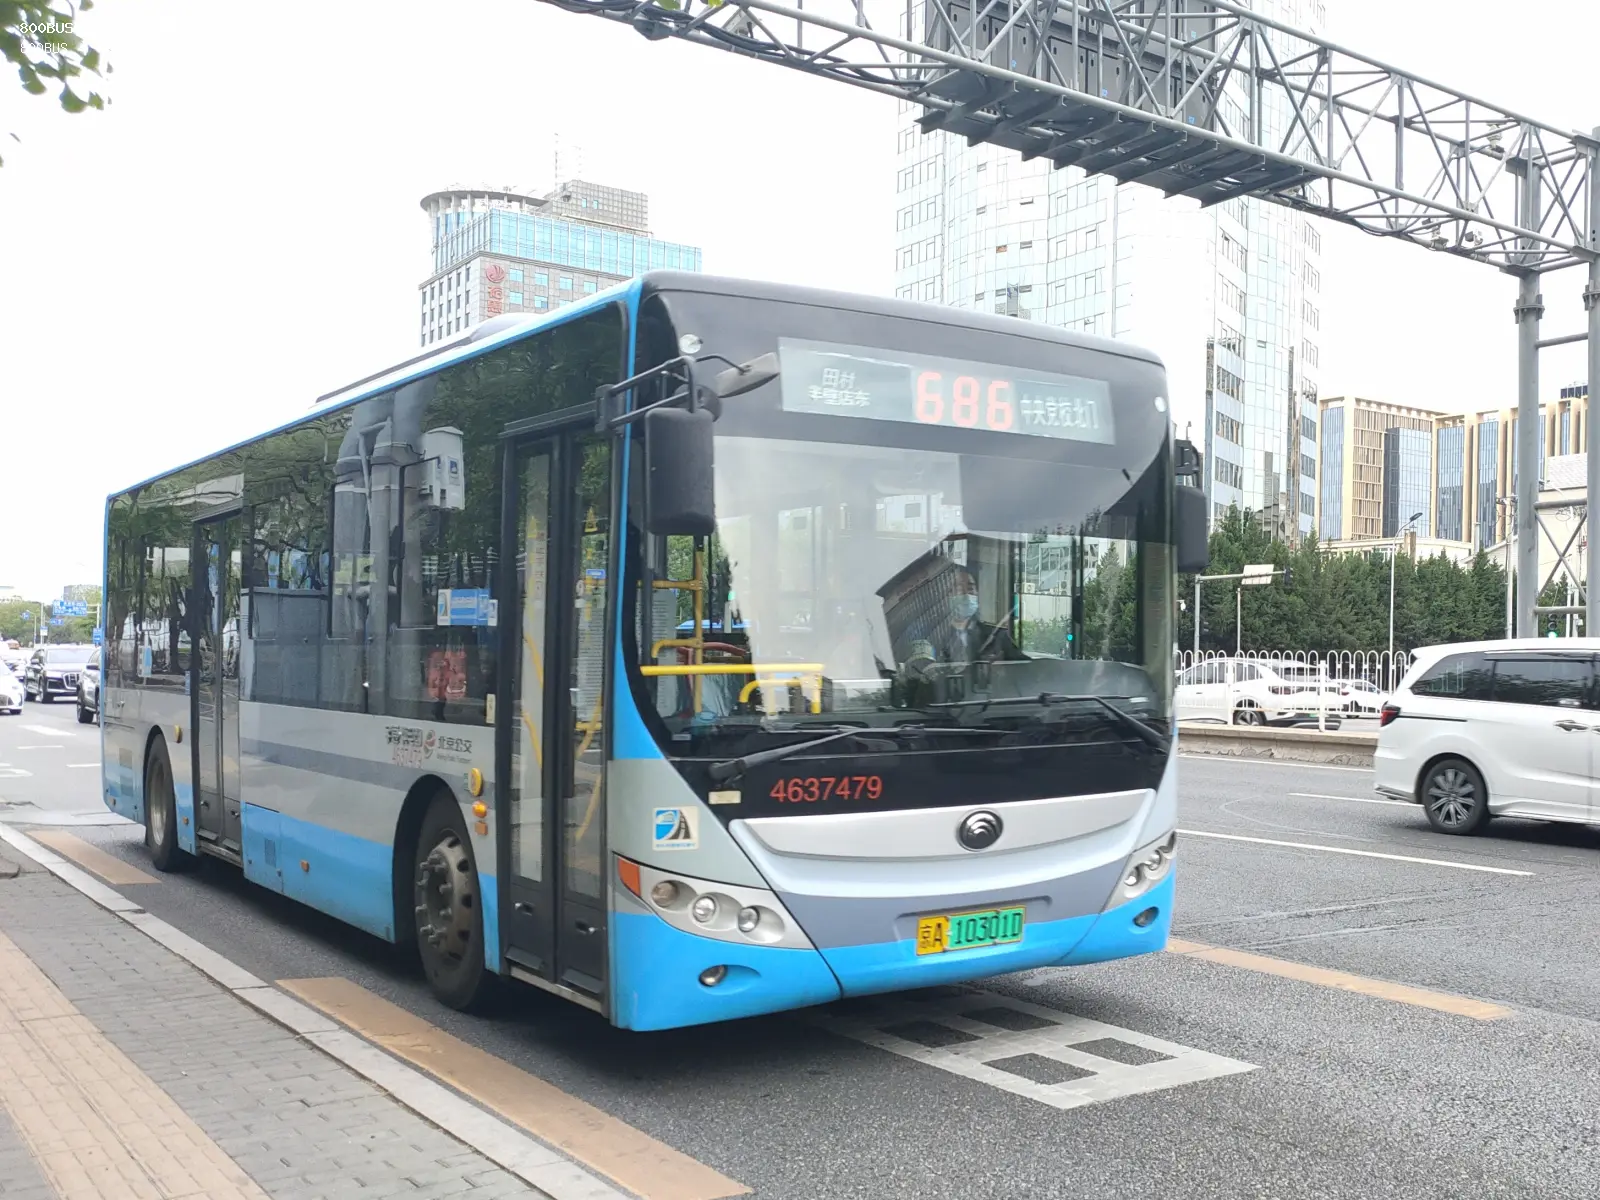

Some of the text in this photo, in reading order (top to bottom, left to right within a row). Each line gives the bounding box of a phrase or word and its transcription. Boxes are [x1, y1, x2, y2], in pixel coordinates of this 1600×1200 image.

[915, 370, 1014, 430] 686
[438, 736, 473, 753] 北京公交
[769, 775, 883, 803] 4637479
